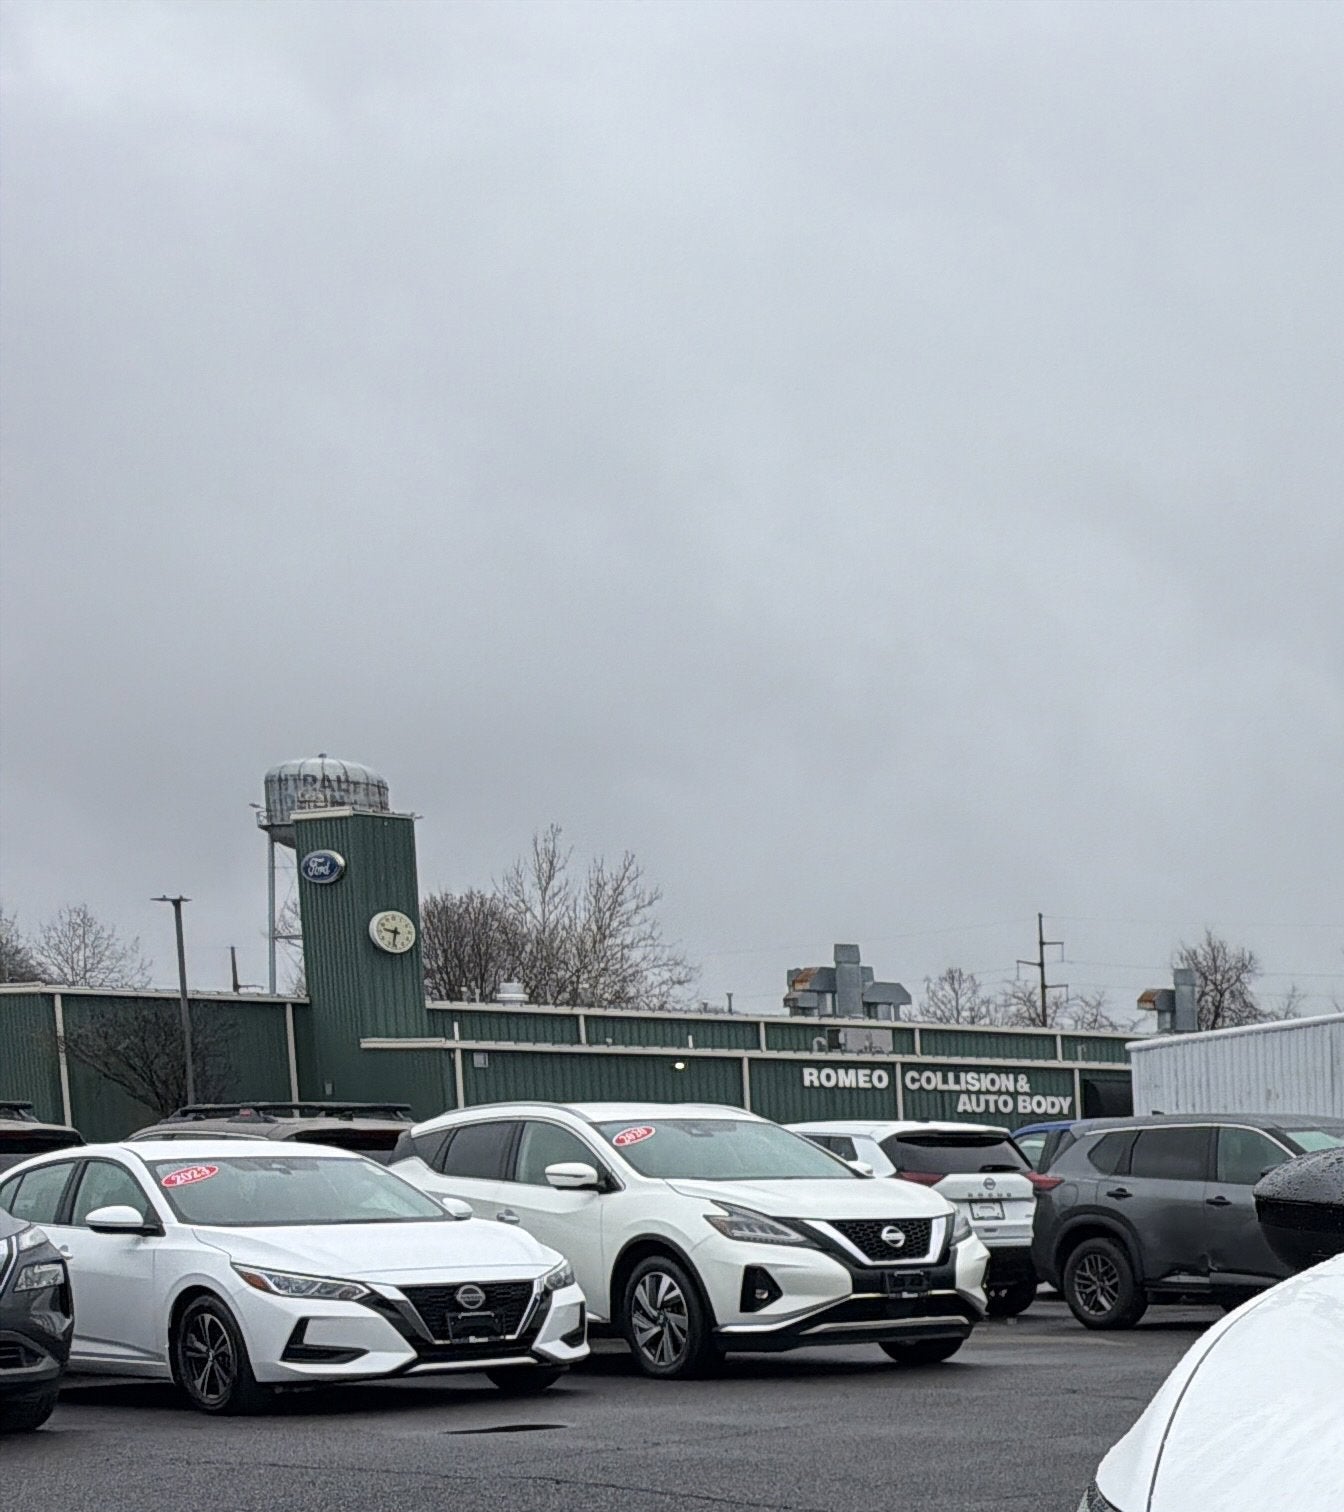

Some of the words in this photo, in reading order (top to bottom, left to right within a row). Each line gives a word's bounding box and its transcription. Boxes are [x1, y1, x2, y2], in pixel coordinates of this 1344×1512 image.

[308, 857, 330, 876] Ford
[803, 1067, 889, 1089] ROMEO
[957, 1095, 1014, 1113] AUTO
[1017, 1096, 1072, 1115] BODY
